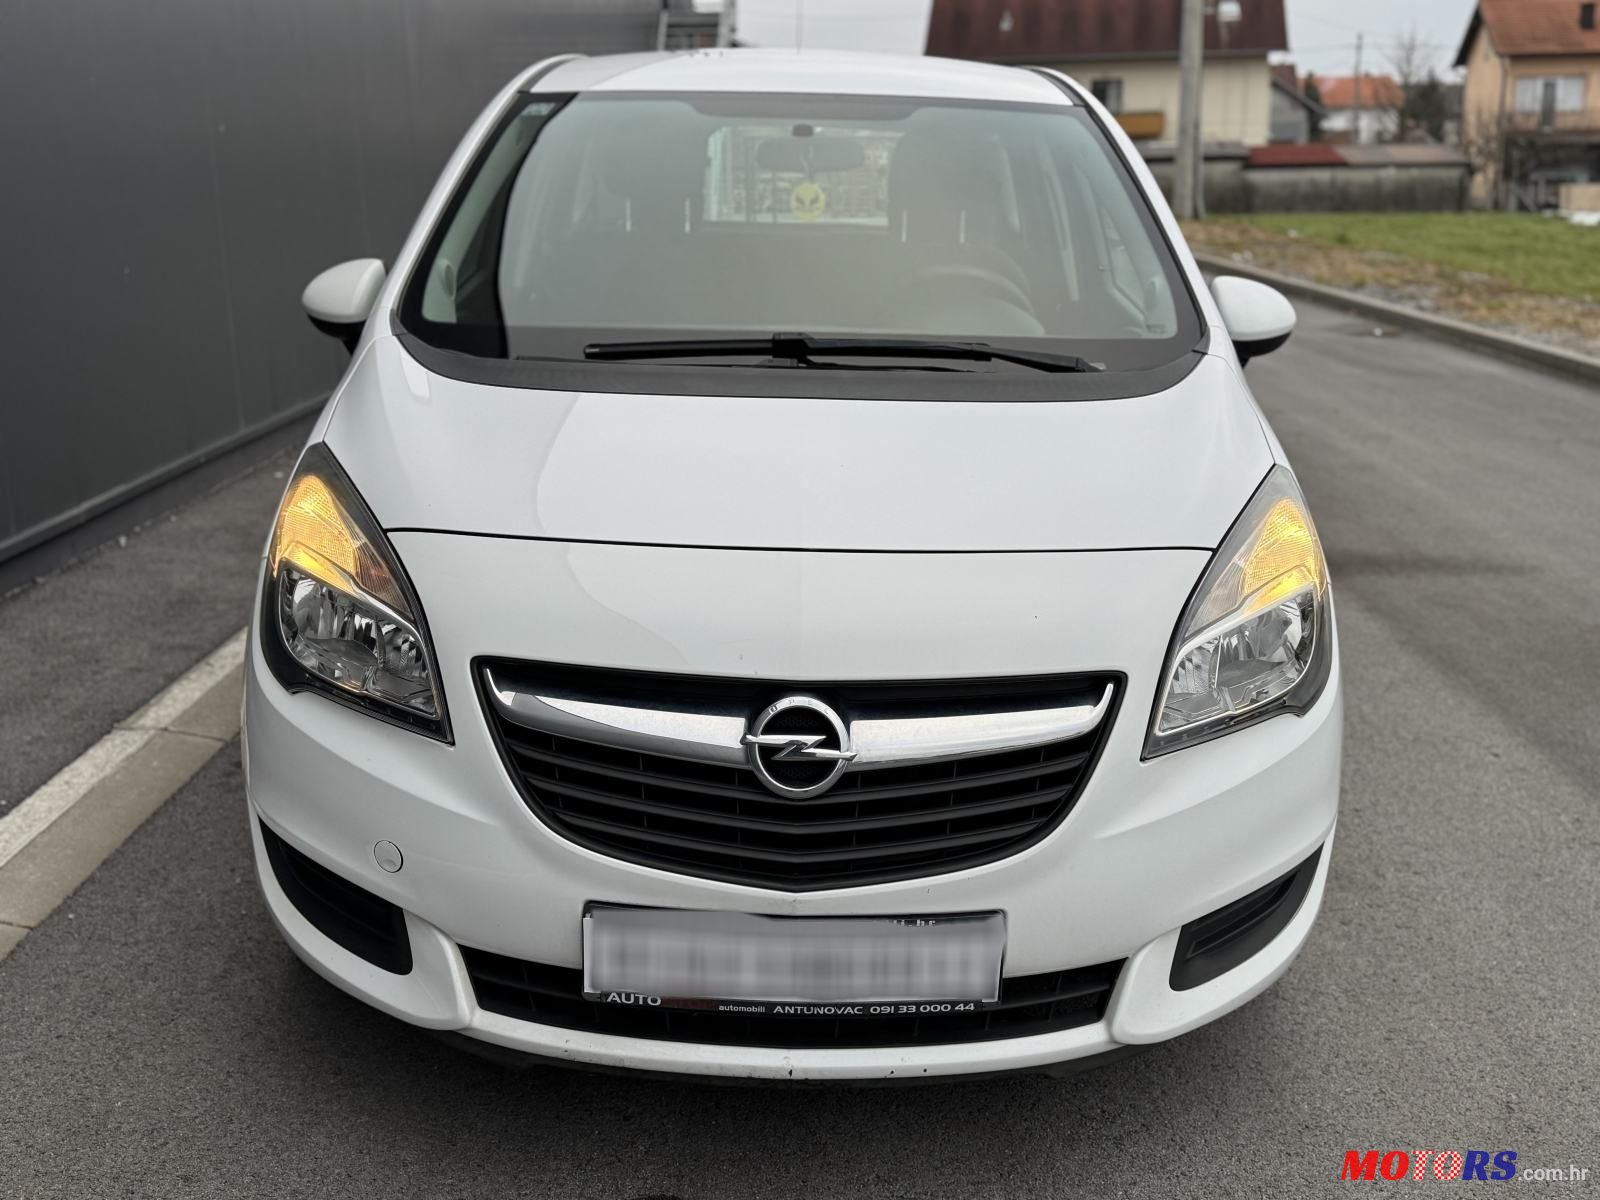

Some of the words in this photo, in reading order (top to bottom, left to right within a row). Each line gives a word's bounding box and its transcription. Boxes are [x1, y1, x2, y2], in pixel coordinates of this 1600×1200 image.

[768, 698, 830, 716] OPEL
[606, 992, 662, 1006] AUTO
[898, 1005, 916, 1013] 33
[919, 1004, 951, 1013] 000
[954, 1003, 975, 1011] 44
